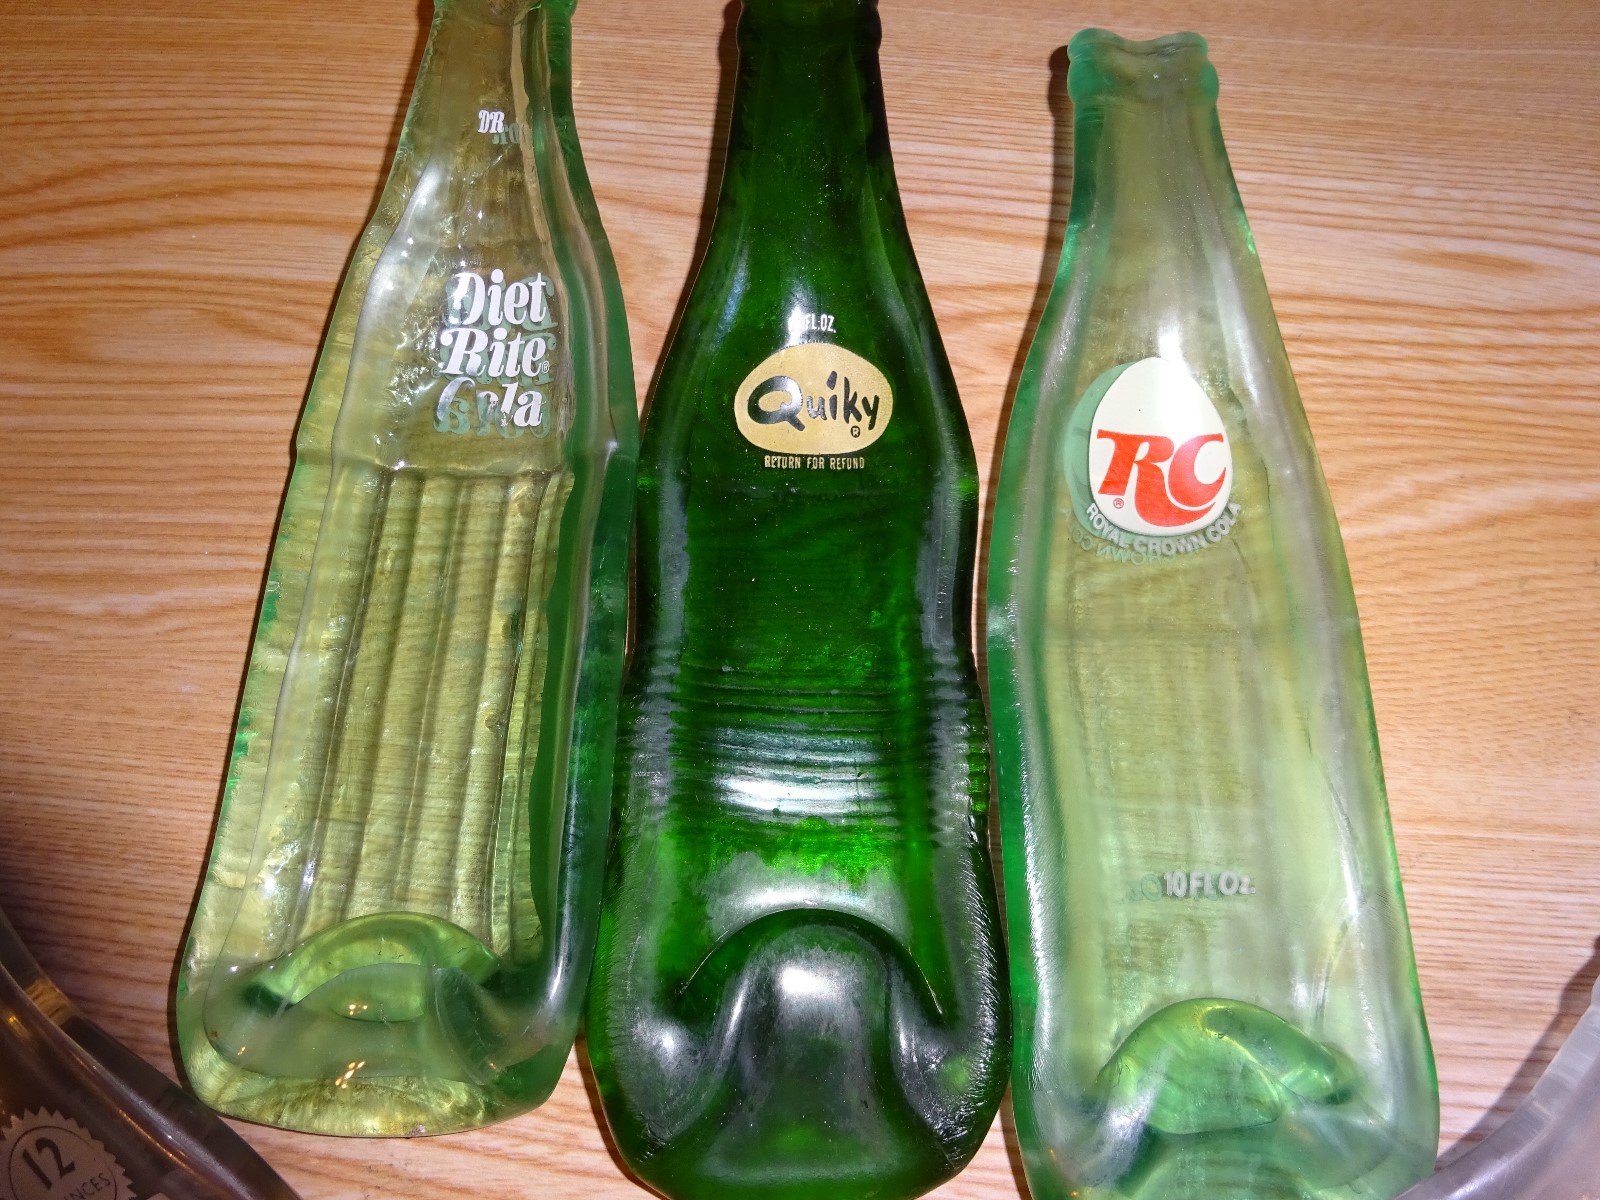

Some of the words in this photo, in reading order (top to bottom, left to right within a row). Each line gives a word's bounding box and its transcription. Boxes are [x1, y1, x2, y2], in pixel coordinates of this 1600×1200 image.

[478, 109, 504, 133] DR
[449, 269, 547, 326] Diet
[440, 328, 542, 377] Rite
[747, 371, 880, 431] Quiky
[765, 455, 800, 468] RETURN
[807, 457, 825, 469] FOR
[830, 457, 865, 470] REFUND
[1097, 429, 1227, 527] RC
[1086, 503, 1129, 549] ROYAL
[1133, 534, 1208, 556] CROWN
[1205, 503, 1241, 542] COLA
[22, 1137, 76, 1190] 12
[65, 1173, 111, 1200] NCES
